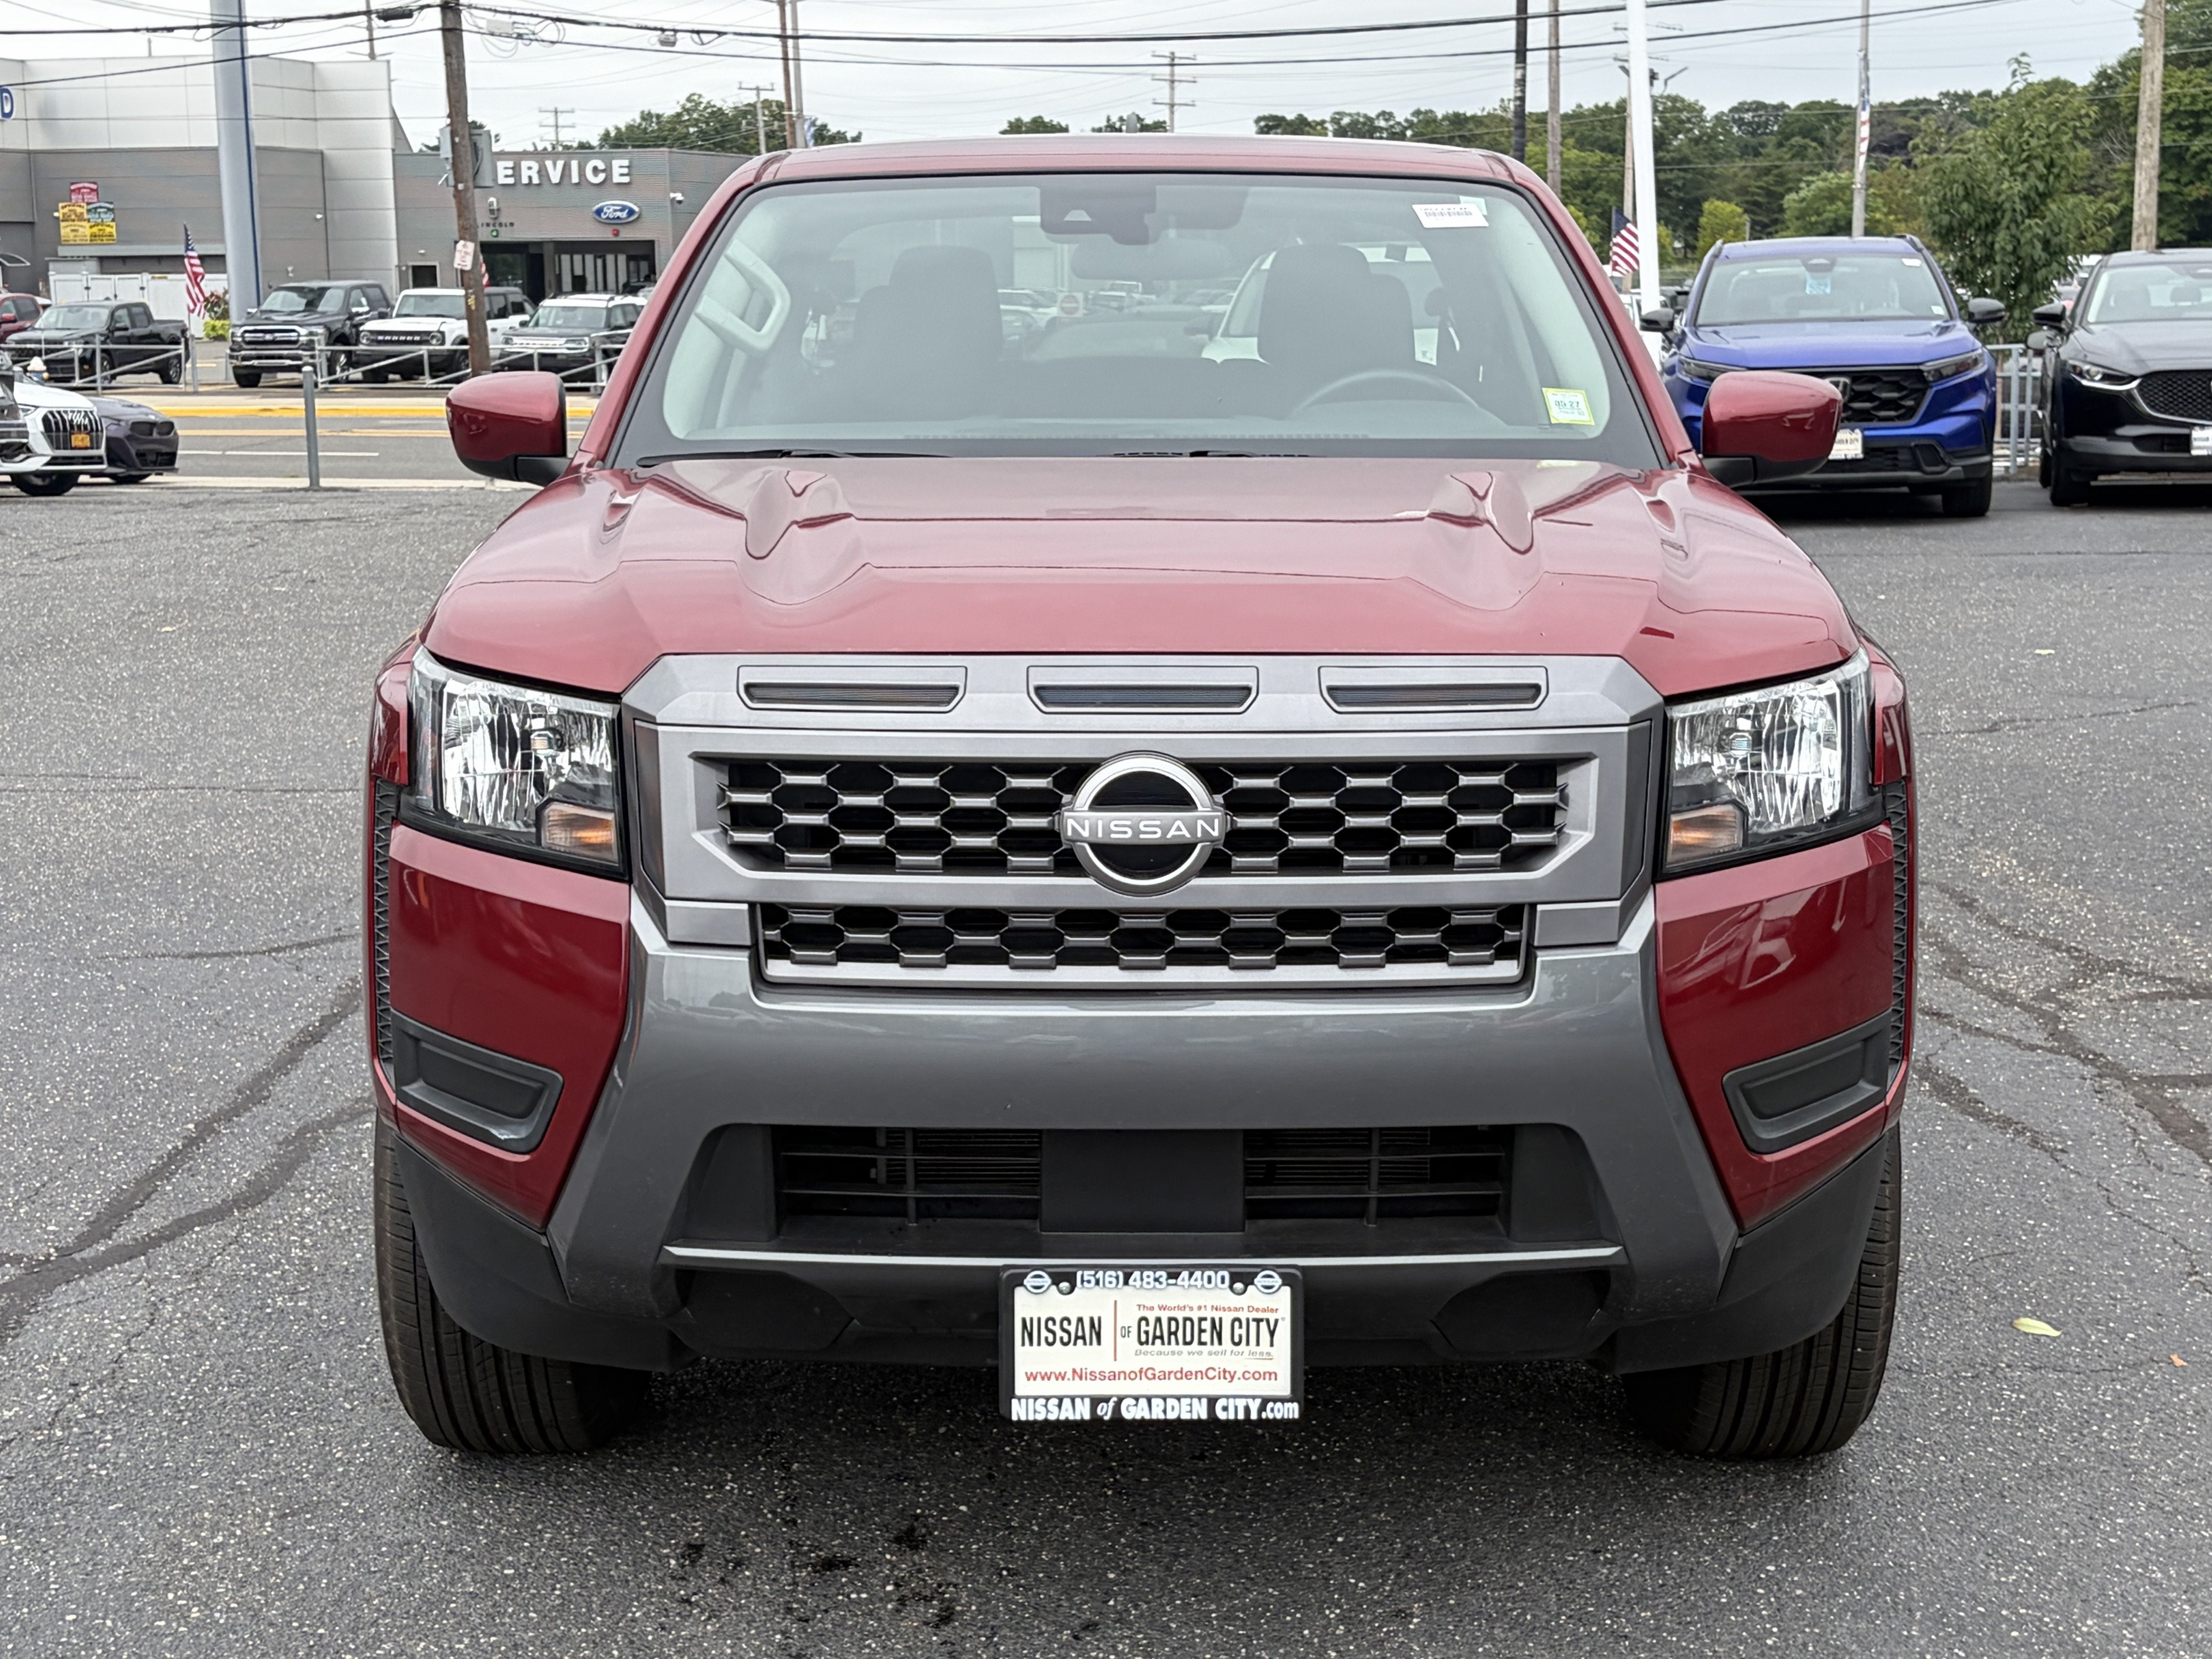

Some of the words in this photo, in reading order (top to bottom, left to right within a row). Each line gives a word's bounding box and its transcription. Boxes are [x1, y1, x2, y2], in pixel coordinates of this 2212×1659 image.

[496, 159, 630, 184] ERVICE
[601, 206, 629, 218] Ford
[1066, 818, 1219, 839] NISSAN
[1076, 1270, 1123, 1289] (516)
[1128, 1270, 1230, 1289] 483-4400
[1247, 1305, 1279, 1313] Dealer
[1020, 1316, 1102, 1347] NISSAN
[1120, 1326, 1132, 1338] OF
[1137, 1316, 1223, 1346] GARDEN
[1230, 1316, 1279, 1348] CITY
[1025, 1367, 1278, 1383] www.NissanofGardenCity.com
[1011, 1398, 1091, 1420] NISSAN
[1096, 1396, 1118, 1420] of
[1120, 1397, 1207, 1420] GARDEN
[1215, 1398, 1299, 1420] CITY.com
